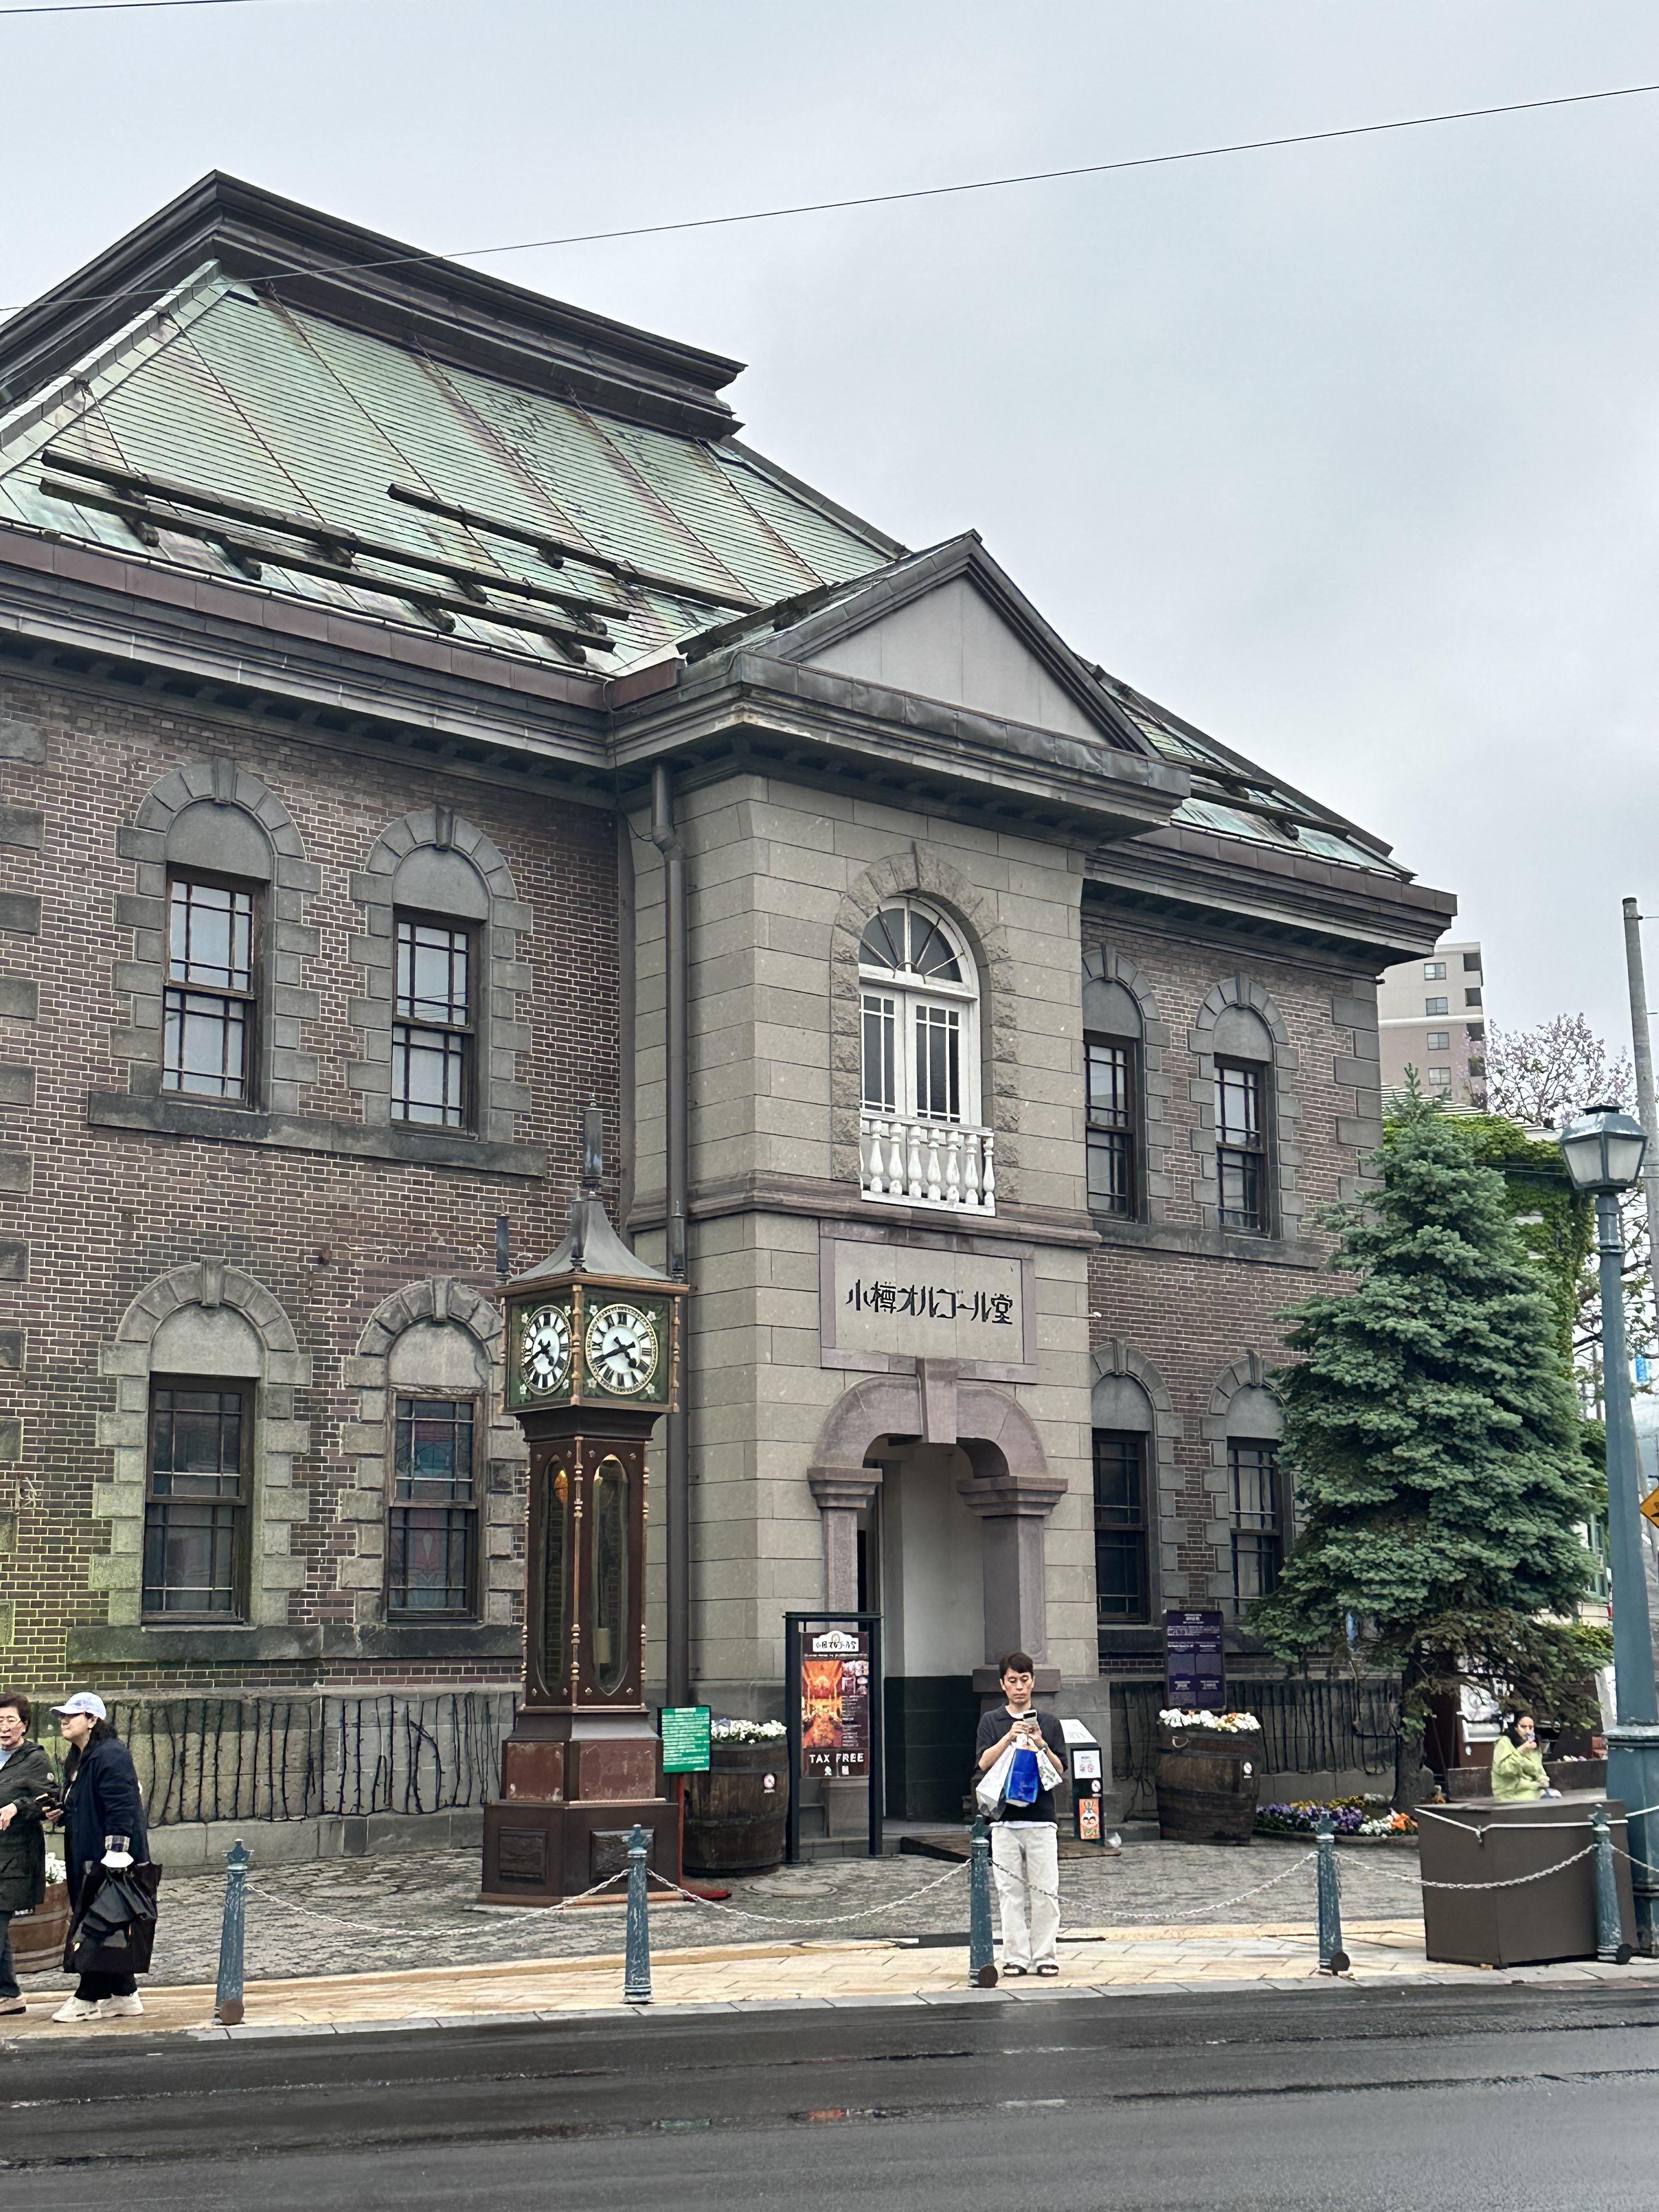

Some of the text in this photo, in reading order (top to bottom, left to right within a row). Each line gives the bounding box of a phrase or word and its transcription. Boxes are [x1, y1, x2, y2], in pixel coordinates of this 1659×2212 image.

[845, 1279, 1013, 1325] 小樽オルゴール堂
[809, 1753, 864, 1764] TAX FREE
